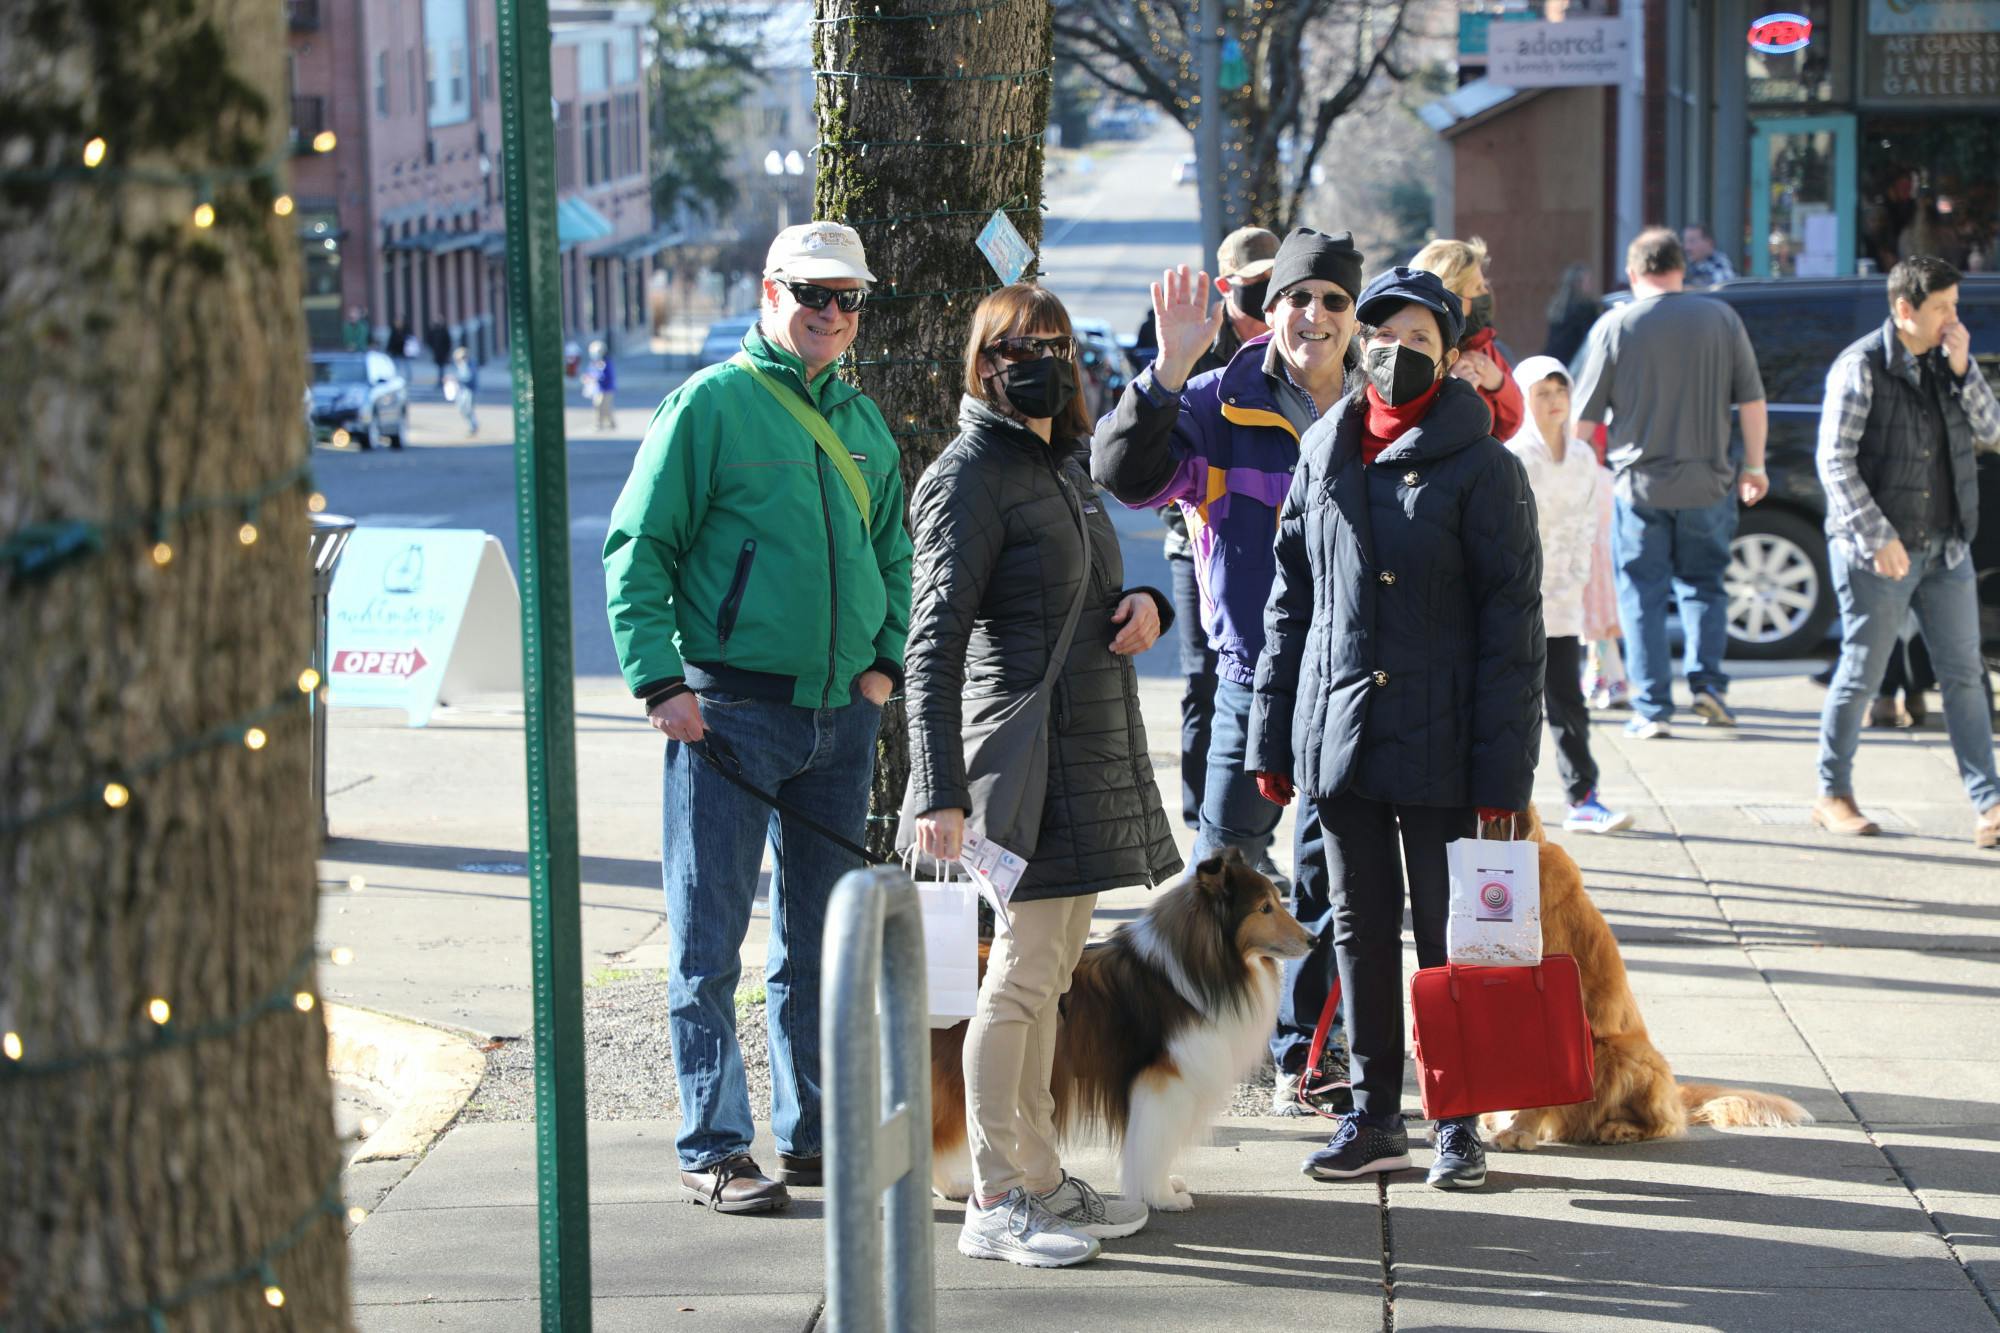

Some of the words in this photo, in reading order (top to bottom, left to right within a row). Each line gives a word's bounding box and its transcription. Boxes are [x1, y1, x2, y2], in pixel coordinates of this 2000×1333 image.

[1518, 28, 1604, 55] adored
[1884, 36, 1918, 53] ART
[1922, 35, 1983, 54] GLASS
[1884, 55, 1999, 74] JEWELRY
[1884, 76, 1998, 95] GALLERY
[343, 652, 415, 675] OPEN
